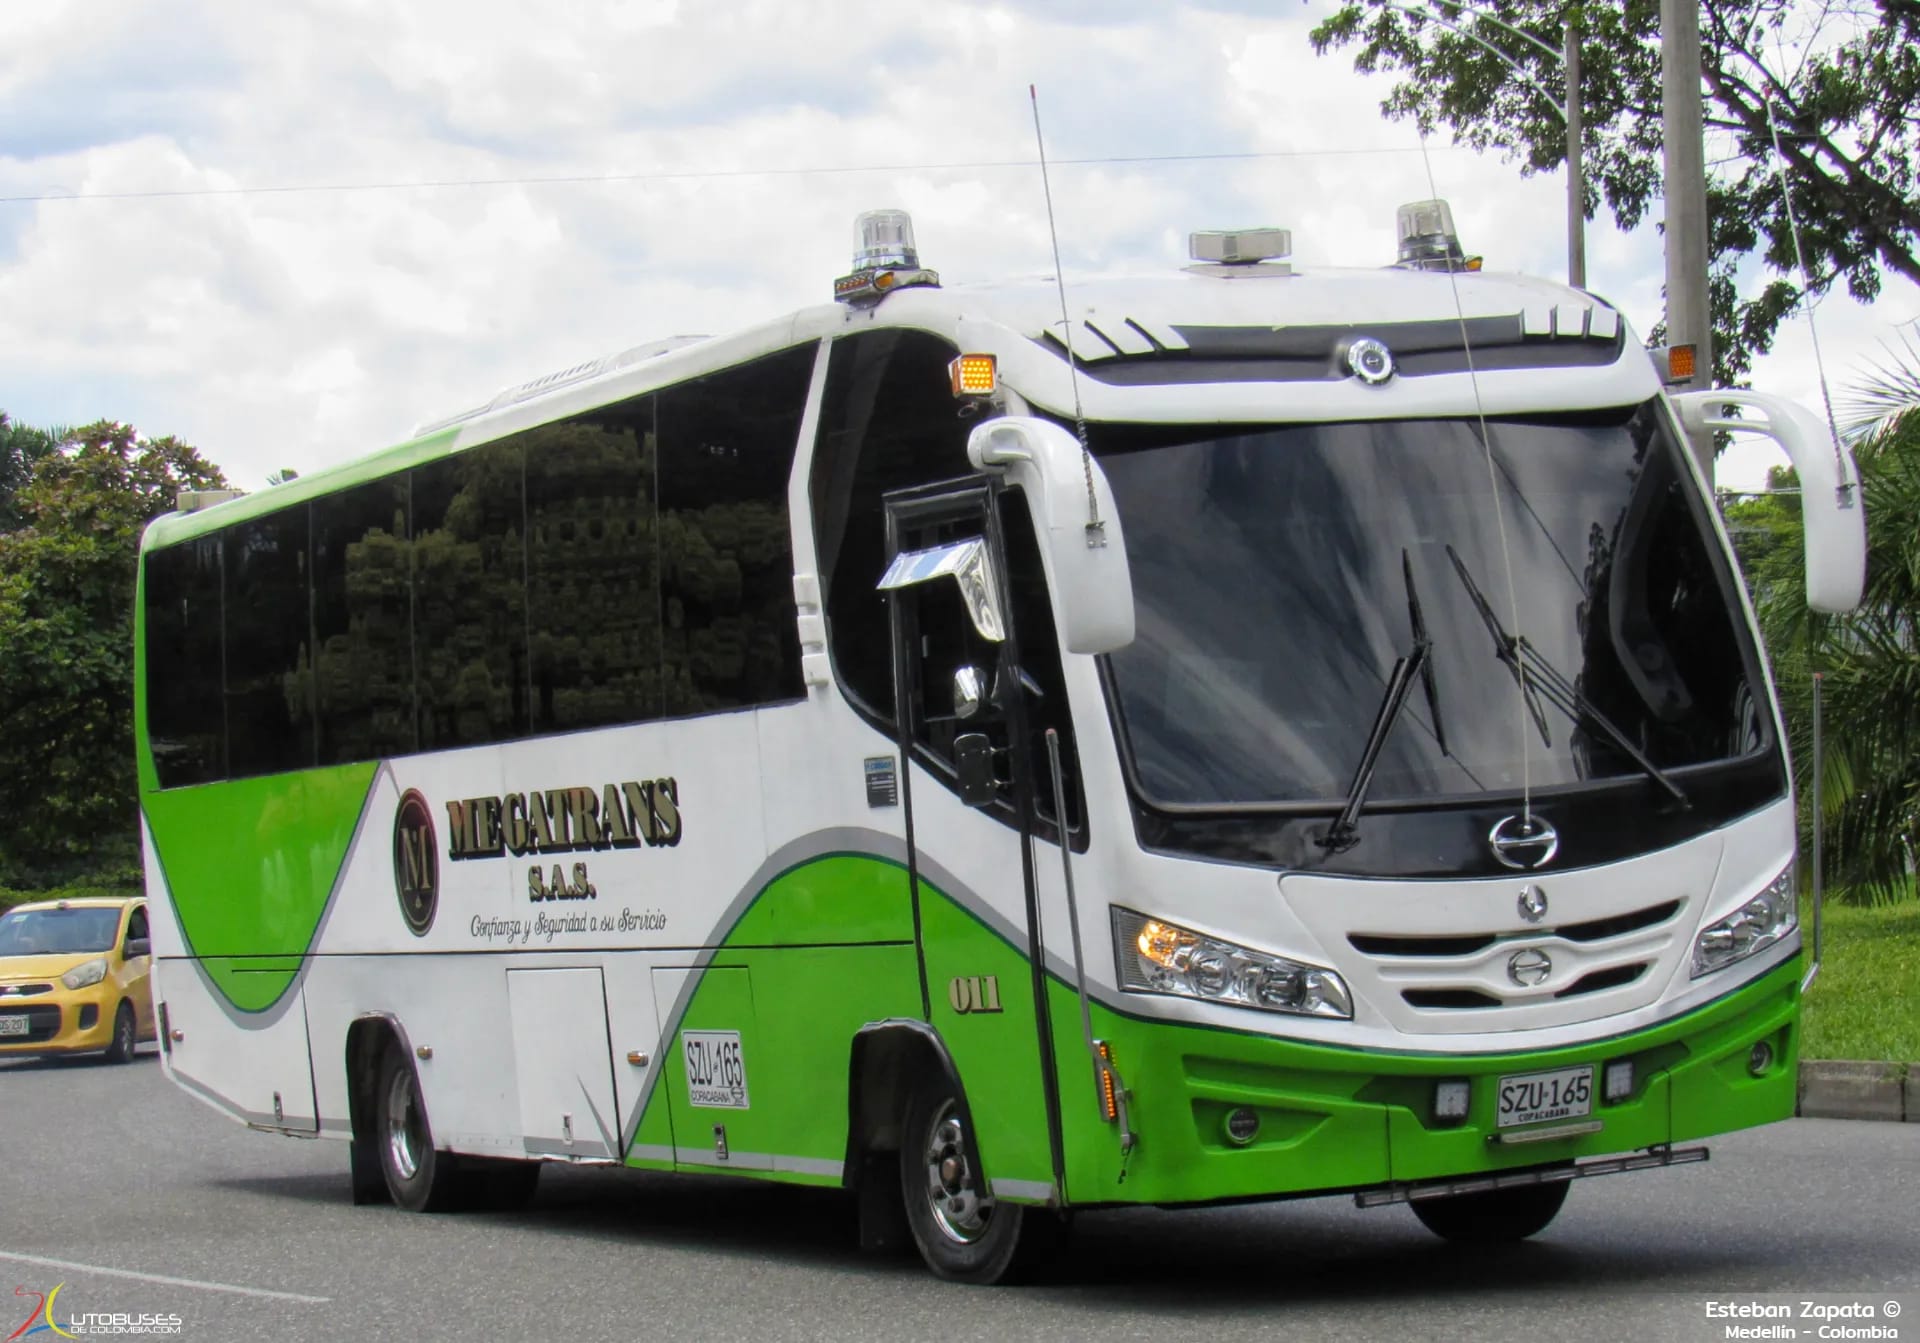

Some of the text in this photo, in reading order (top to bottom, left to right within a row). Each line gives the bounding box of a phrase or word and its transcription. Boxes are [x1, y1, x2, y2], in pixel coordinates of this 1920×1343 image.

[446, 777, 682, 861] MEGATRANS
[528, 862, 597, 902] S.A.S.
[470, 907, 667, 944] Confianza y Seguridad a su Servicio
[1518, 1107, 1570, 1122] COPACABANA
